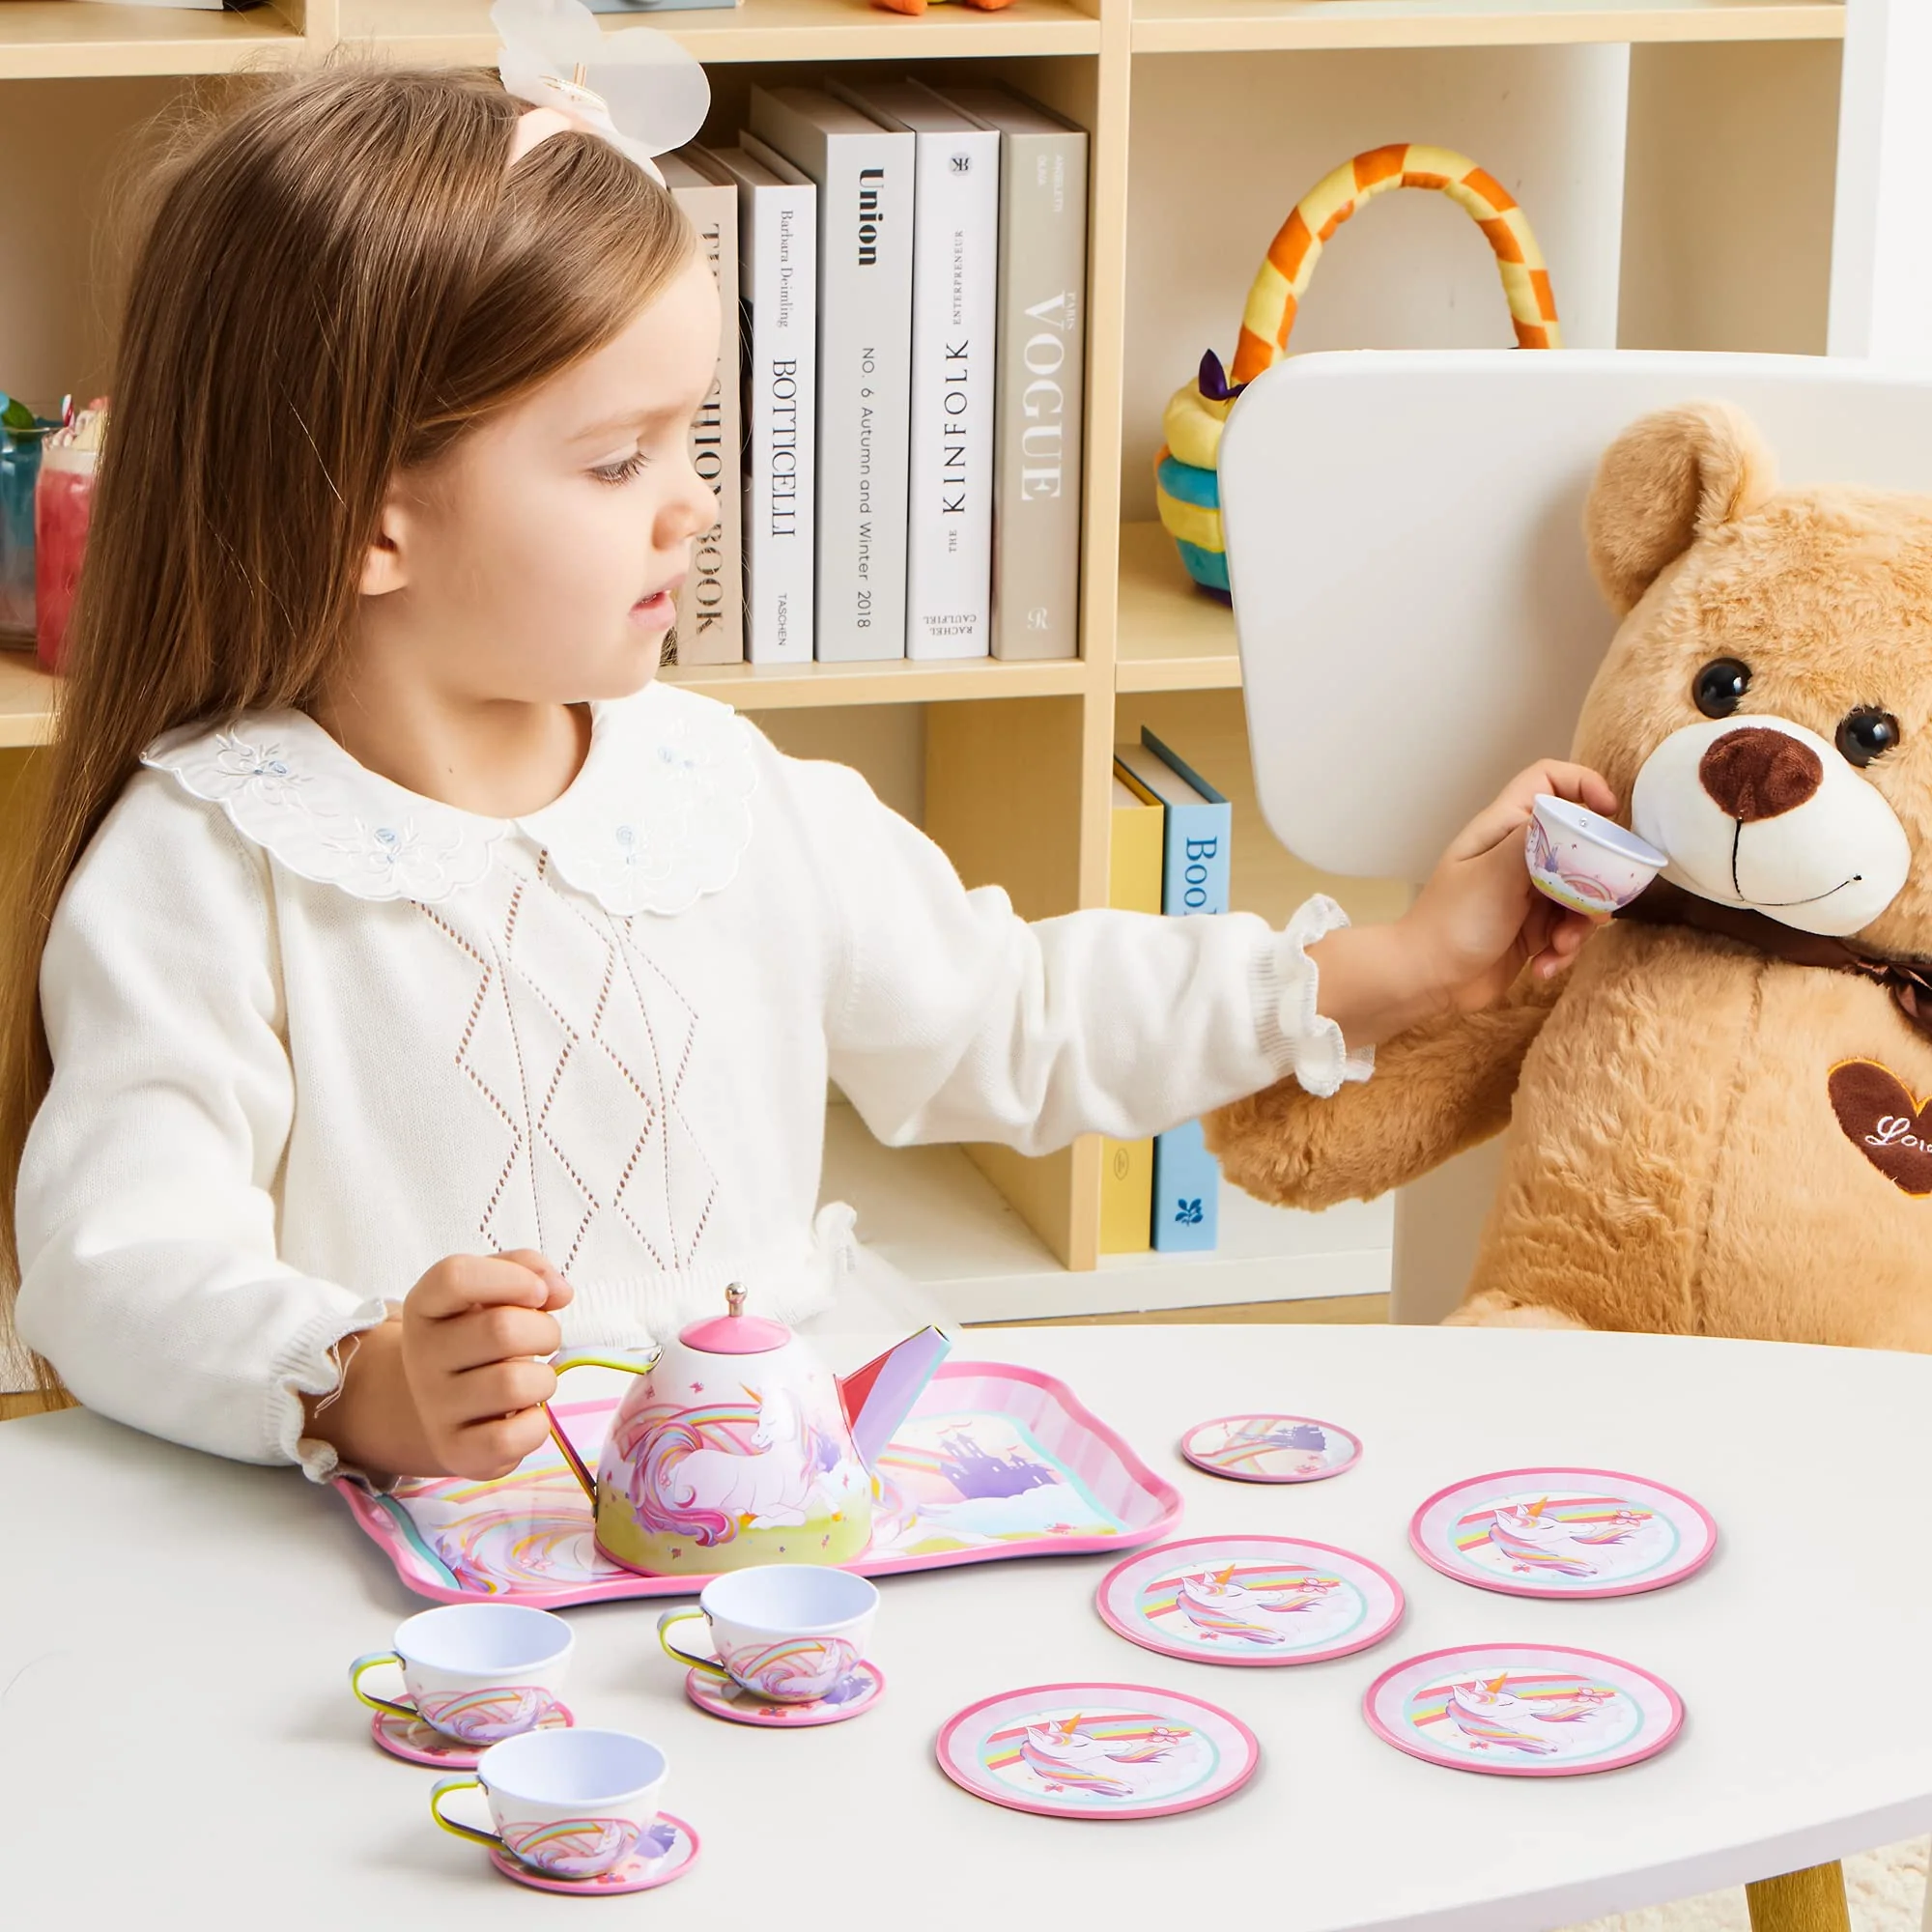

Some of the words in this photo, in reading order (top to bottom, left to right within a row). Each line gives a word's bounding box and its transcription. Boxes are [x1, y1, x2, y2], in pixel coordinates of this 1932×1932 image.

[780, 210, 794, 263] Barbara
[858, 167, 885, 267] Union
[777, 267, 796, 328] Deimling
[1065, 292, 1076, 330] PARIS
[861, 347, 875, 378] NO.
[861, 387, 873, 398] 6
[1021, 292, 1065, 501] VOGUE
[771, 357, 798, 538] BOTTICELLI
[860, 406, 874, 475] Autumn
[942, 339, 969, 515] KINFOLK
[858, 479, 872, 514] and
[858, 521, 871, 582] Winter
[947, 529, 957, 554] THE
[696, 523, 723, 635] BOOK
[777, 593, 787, 646] TASCHEN
[857, 590, 871, 629] 2018
[929, 626, 973, 636] RACHEL
[1183, 836, 1218, 916] Boo
